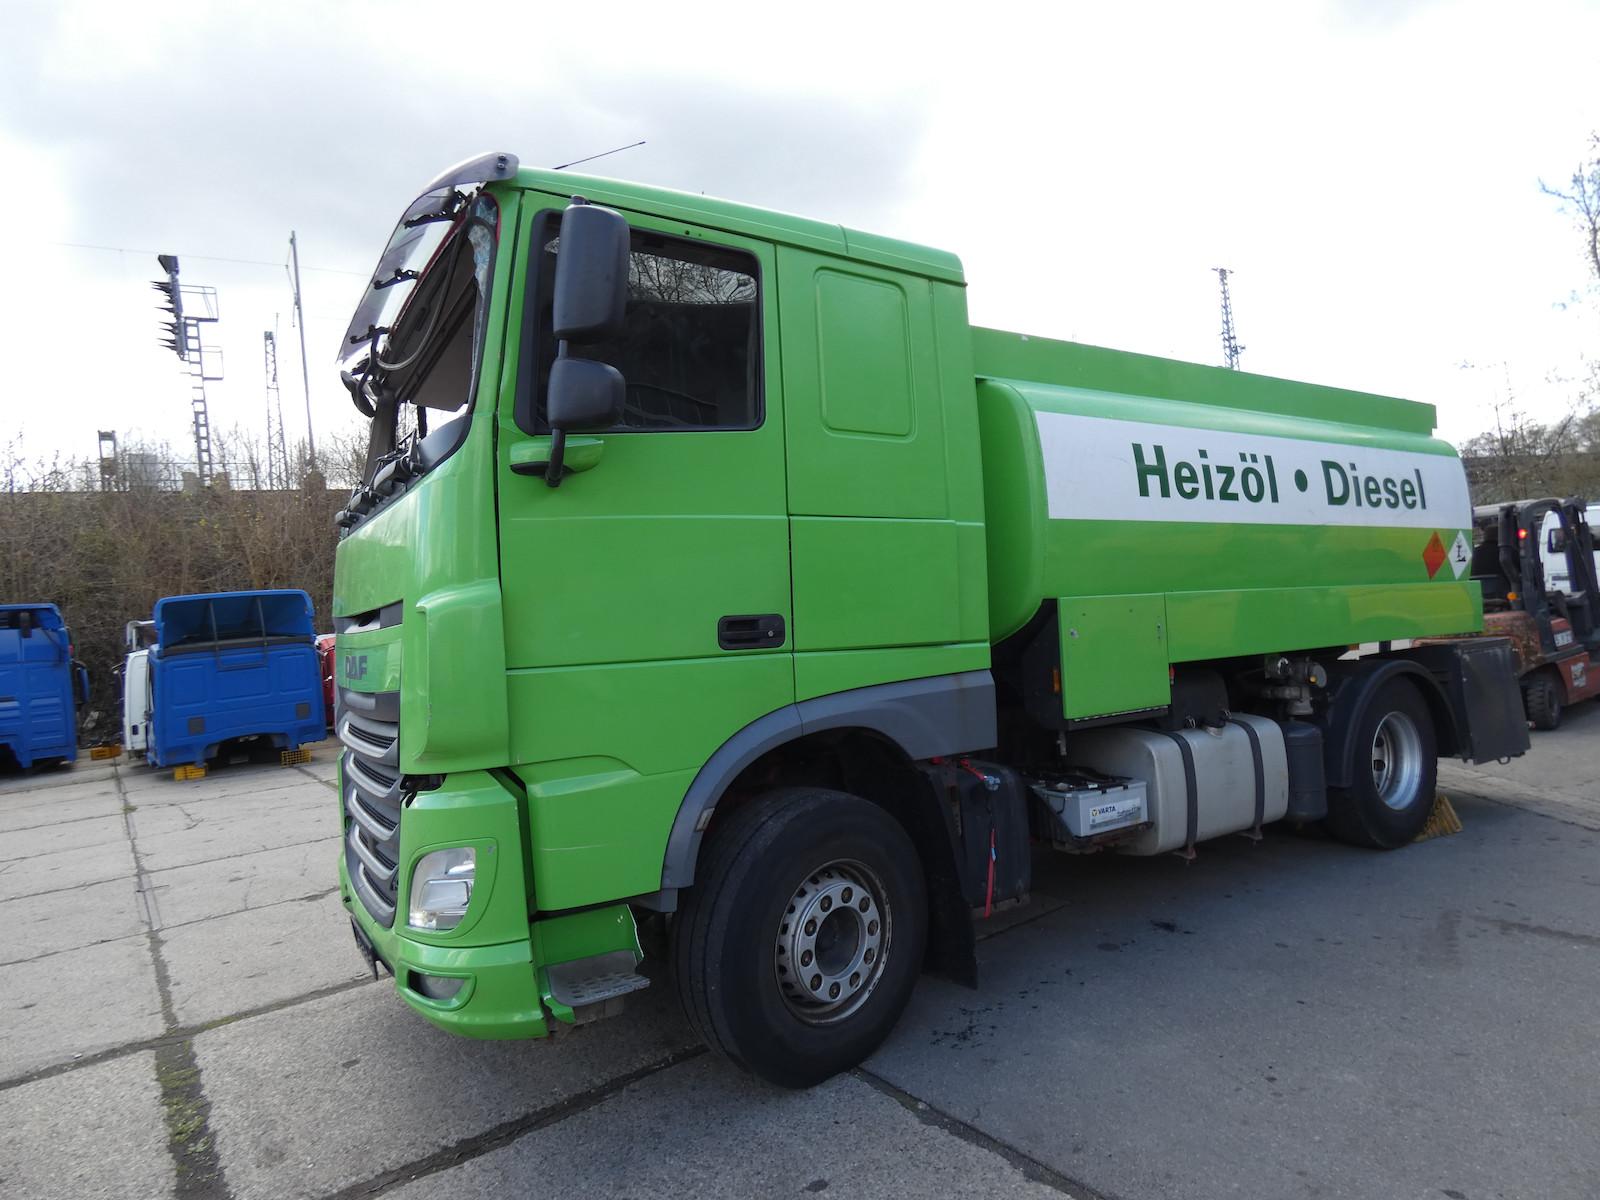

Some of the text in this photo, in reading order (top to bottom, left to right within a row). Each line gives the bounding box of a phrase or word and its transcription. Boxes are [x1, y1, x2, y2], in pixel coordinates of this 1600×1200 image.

[1132, 443, 1427, 510] Heizöl Diesel
[346, 656, 367, 680] DAF
[1098, 805, 1117, 815] VARTA
